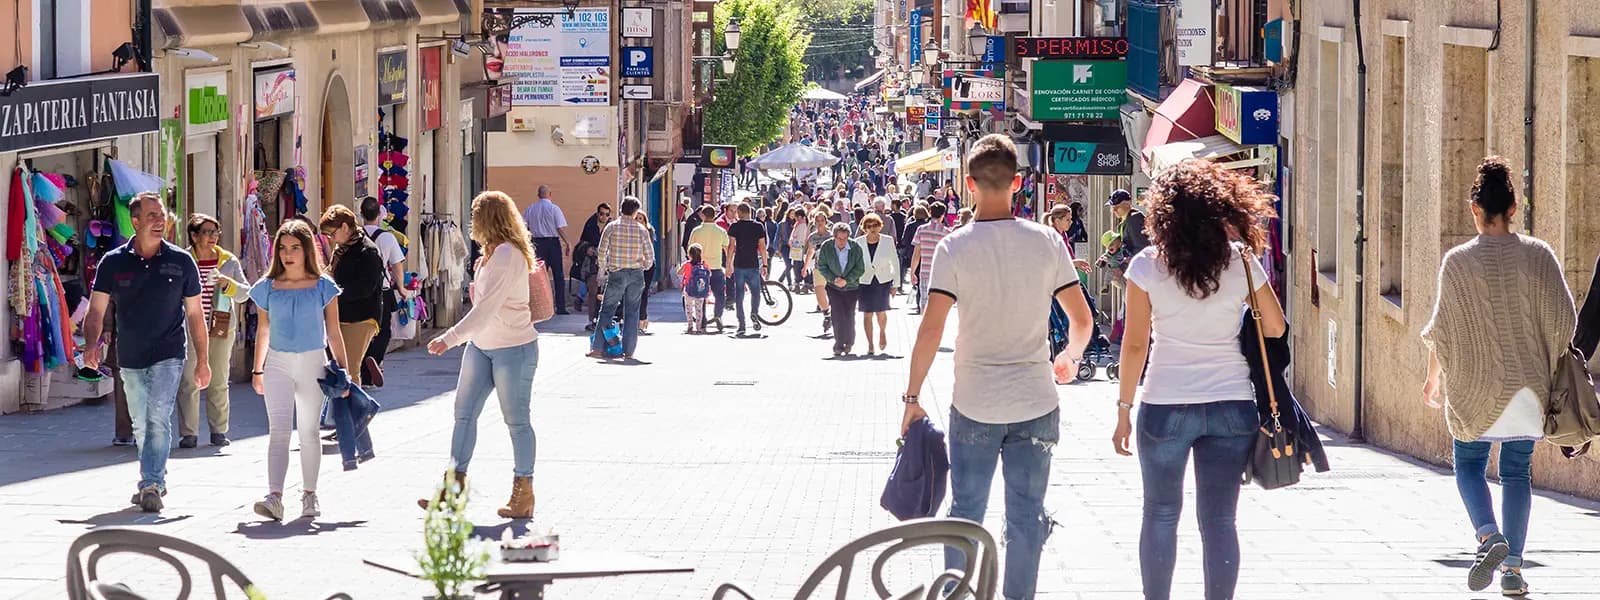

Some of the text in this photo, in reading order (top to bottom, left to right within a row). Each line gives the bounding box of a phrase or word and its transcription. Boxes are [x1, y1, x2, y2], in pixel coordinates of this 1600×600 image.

[579, 13, 592, 22] 102
[594, 13, 608, 22] 103
[1036, 39, 1129, 55] PERMISO
[630, 50, 647, 66] P
[955, 91, 1002, 99] CLORS
[1, 89, 157, 138] ZAPATERIA FANTASIA
